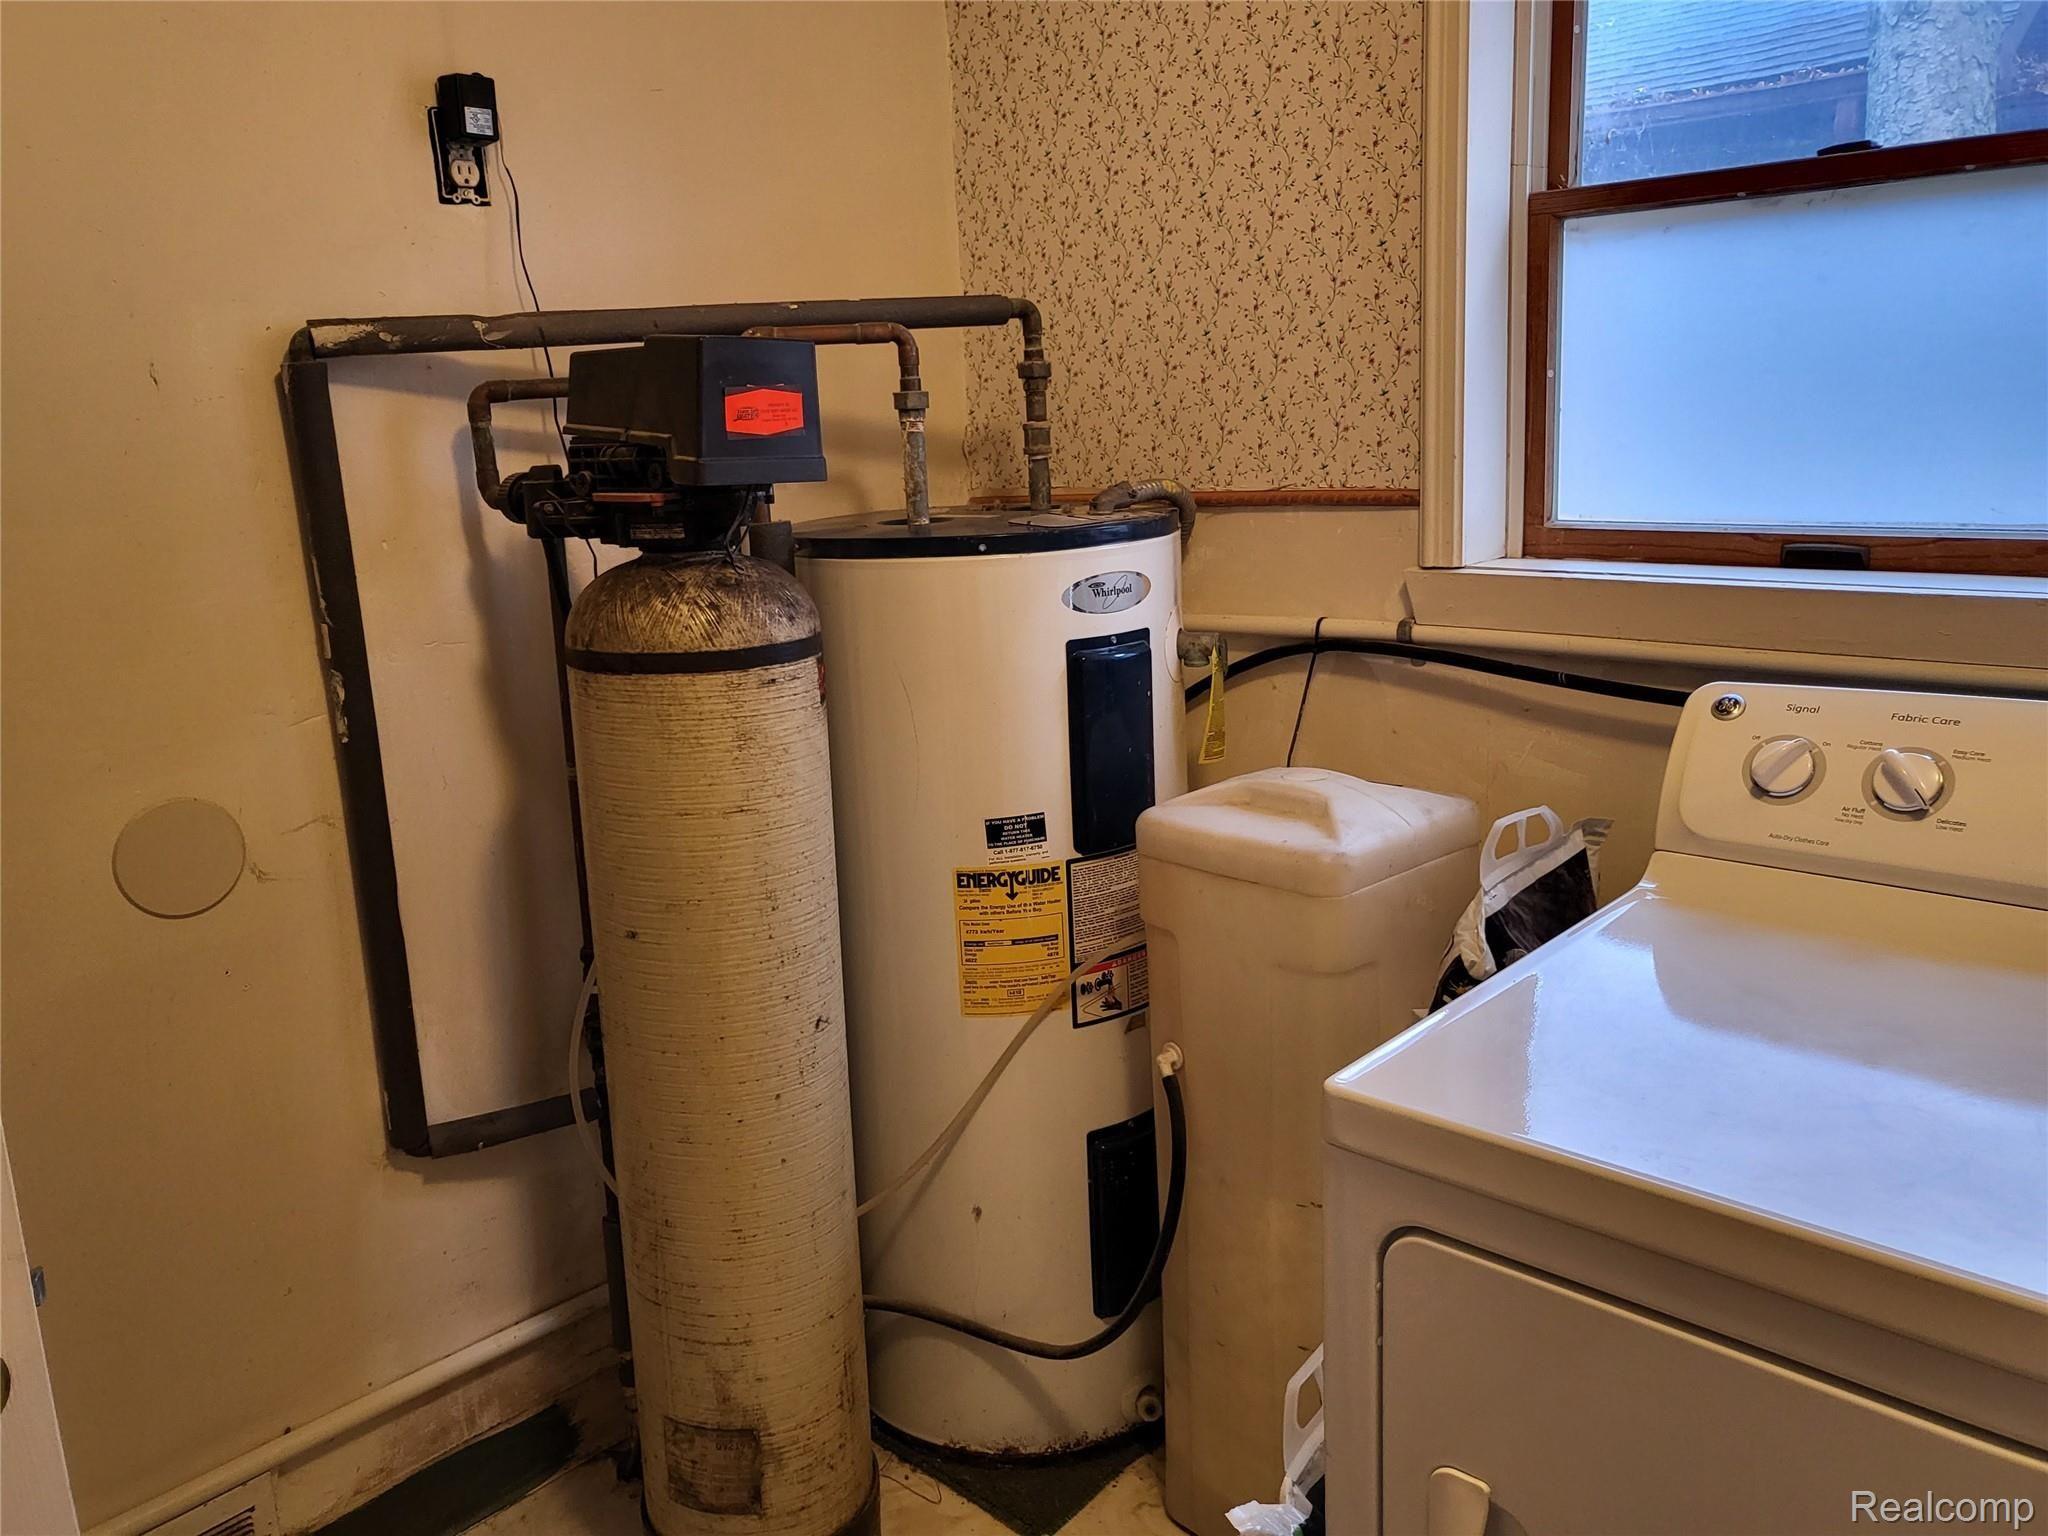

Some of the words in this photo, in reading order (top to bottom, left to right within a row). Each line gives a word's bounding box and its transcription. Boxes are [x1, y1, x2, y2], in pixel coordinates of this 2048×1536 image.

[1092, 584, 1132, 598] Whirlpool
[1786, 704, 1820, 714] Signal
[1891, 713, 1928, 724] Fabric
[1932, 716, 1960, 726] Care
[957, 866, 1060, 889] ENERGYGUIDE
